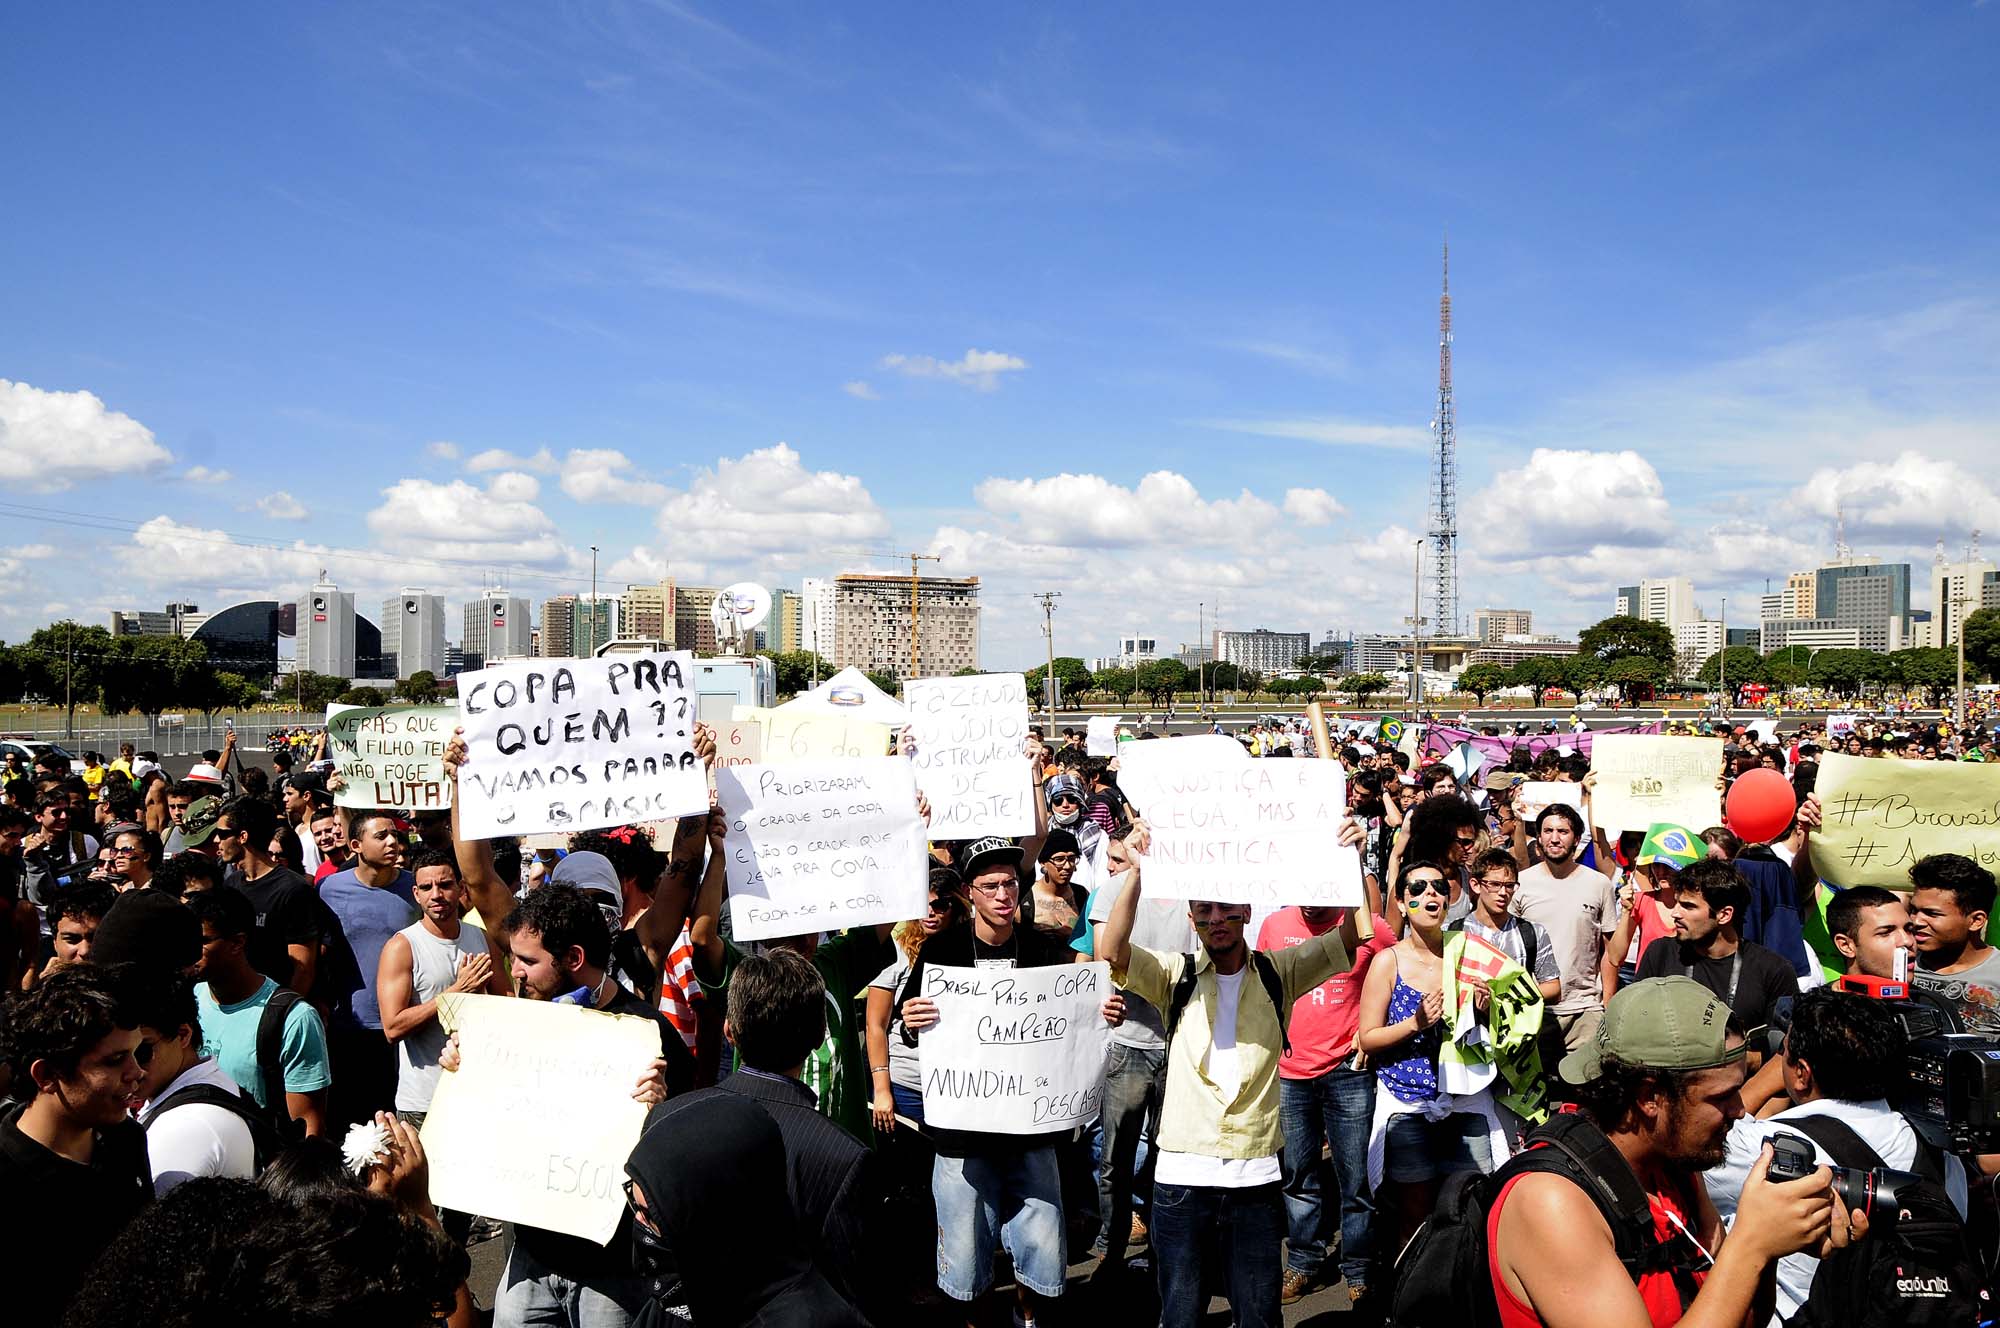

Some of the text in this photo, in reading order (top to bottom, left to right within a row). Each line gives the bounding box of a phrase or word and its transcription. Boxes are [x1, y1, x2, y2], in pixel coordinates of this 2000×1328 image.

[466, 659, 685, 715] COPA PRA
[336, 711, 439, 734] VERÁS QUE
[335, 738, 358, 753] UM
[366, 739, 415, 756] FILHO
[342, 757, 376, 779] NÃO
[384, 763, 429, 782] FOGE
[464, 764, 588, 800] VAMOS
[759, 769, 871, 799] PRIORIZARAM
[951, 770, 990, 797] DE
[1630, 775, 1664, 795] NÃO
[733, 802, 886, 832] O CRAQUE DA COPA
[1257, 801, 1296, 823] MAS
[1316, 801, 1330, 819] A
[735, 848, 750, 863] E
[753, 843, 781, 860] NÃO
[786, 844, 799, 856] O
[859, 832, 892, 849] QUE
[792, 861, 821, 876] PRA
[828, 900, 839, 913] A
[845, 894, 884, 910] COPA
[1036, 994, 1048, 1004] DA
[1053, 968, 1098, 998] COPA
[1702, 1000, 1718, 1027] NEW
[977, 1012, 1069, 1043] CAMPEÃO
[1034, 1075, 1049, 1088] DE
[546, 1153, 617, 1204] ESCOL
